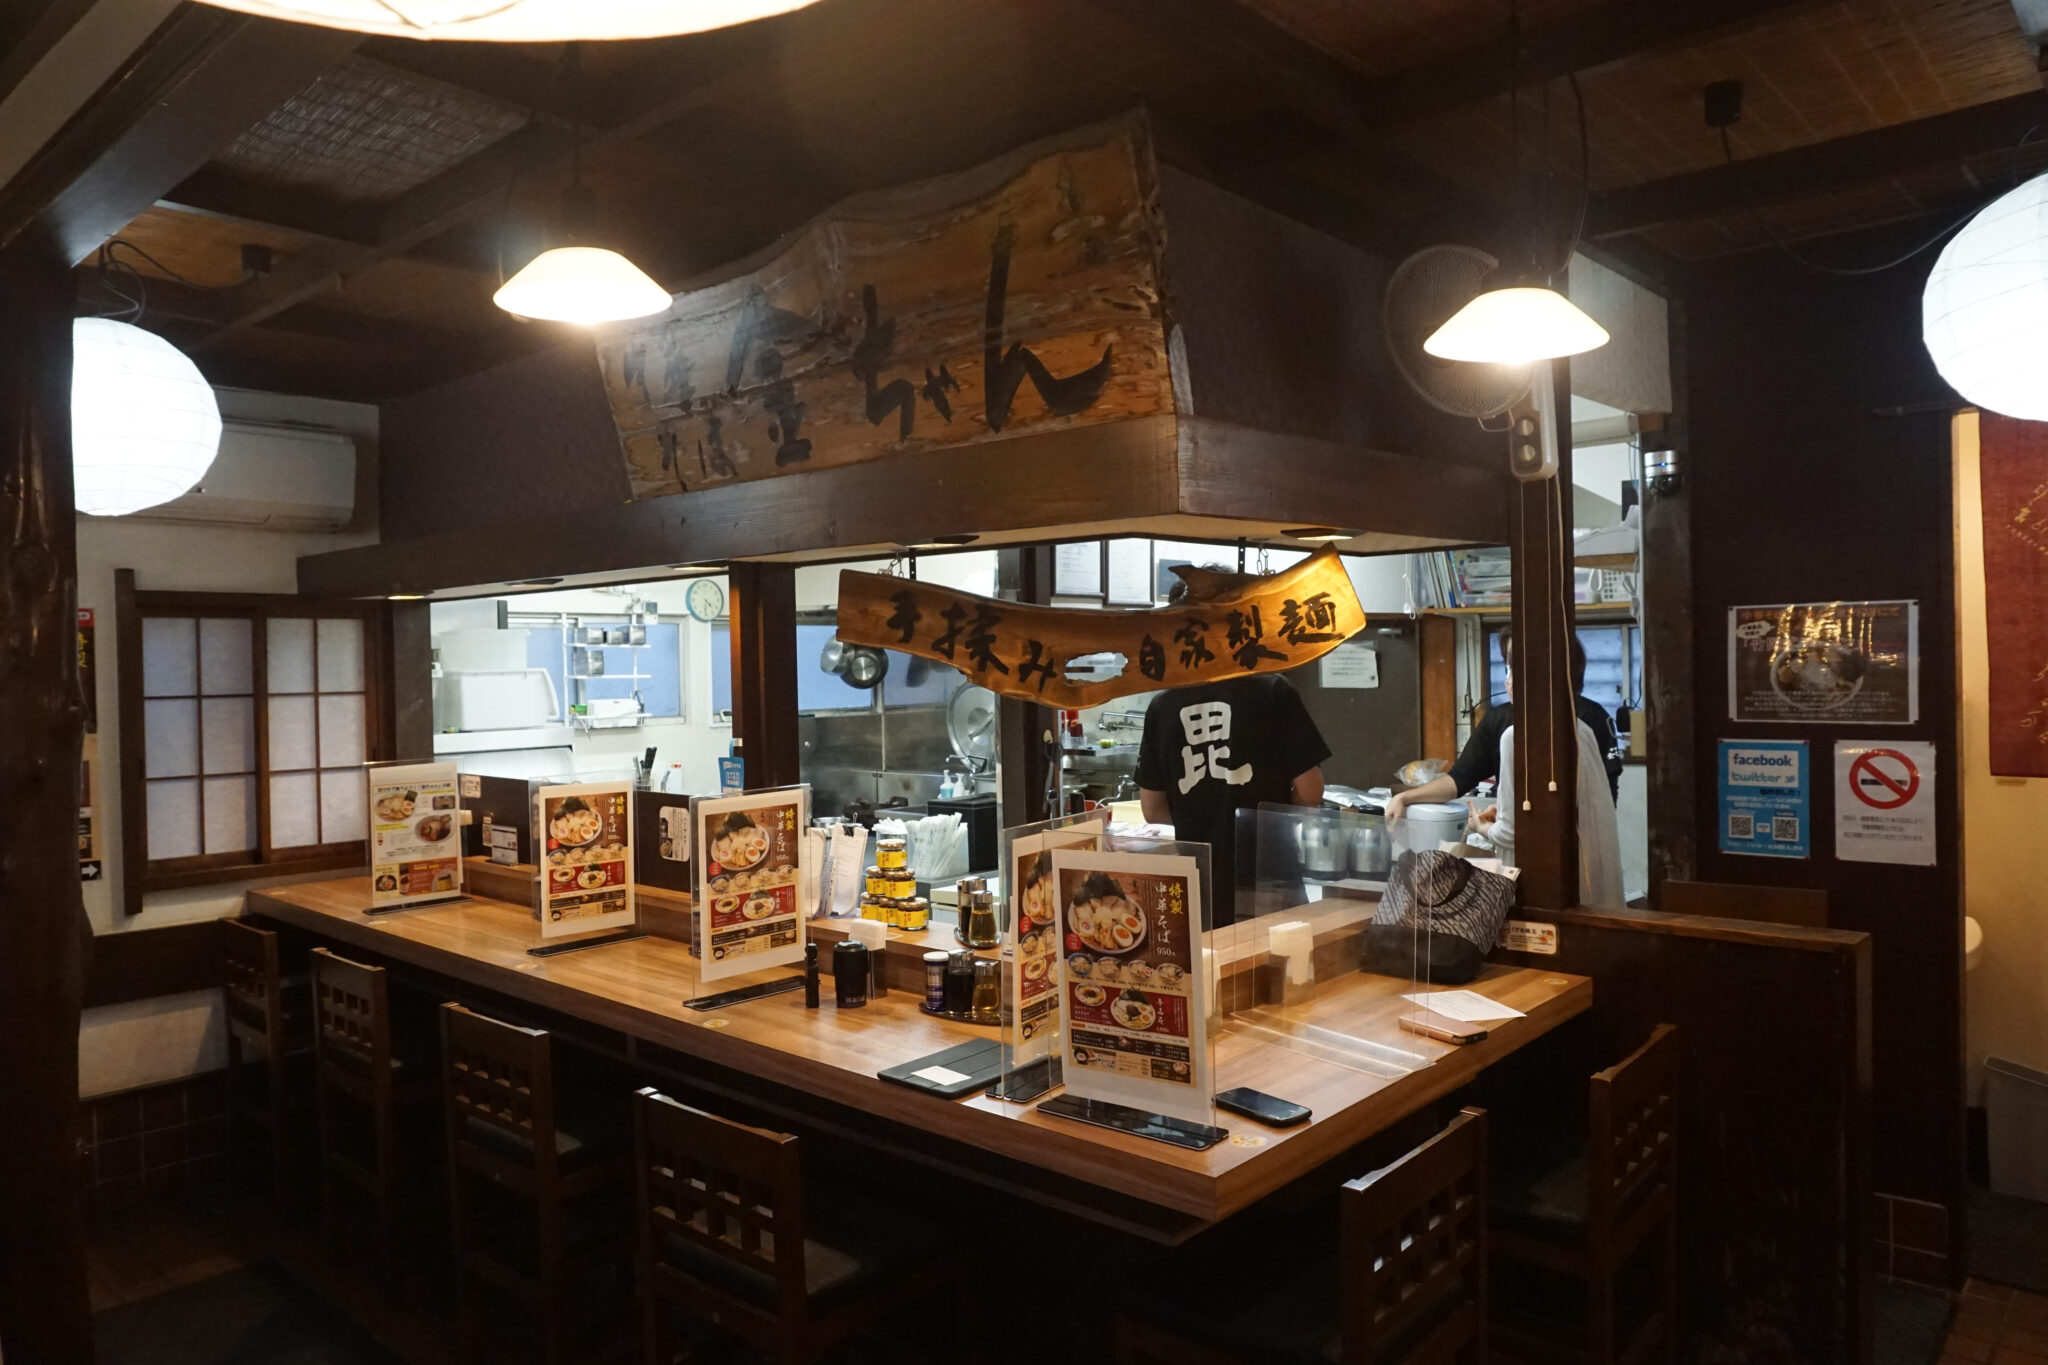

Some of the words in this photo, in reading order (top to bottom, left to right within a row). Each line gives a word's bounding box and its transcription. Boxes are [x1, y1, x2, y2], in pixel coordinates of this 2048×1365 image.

[886, 589, 1058, 692] 手揉み
[1178, 701, 1253, 795] 毘
[1733, 753, 1793, 767] facebook
[1731, 772, 1781, 783] twitter
[1155, 881, 1171, 944] 中華そば
[1168, 882, 1184, 915] 特製
